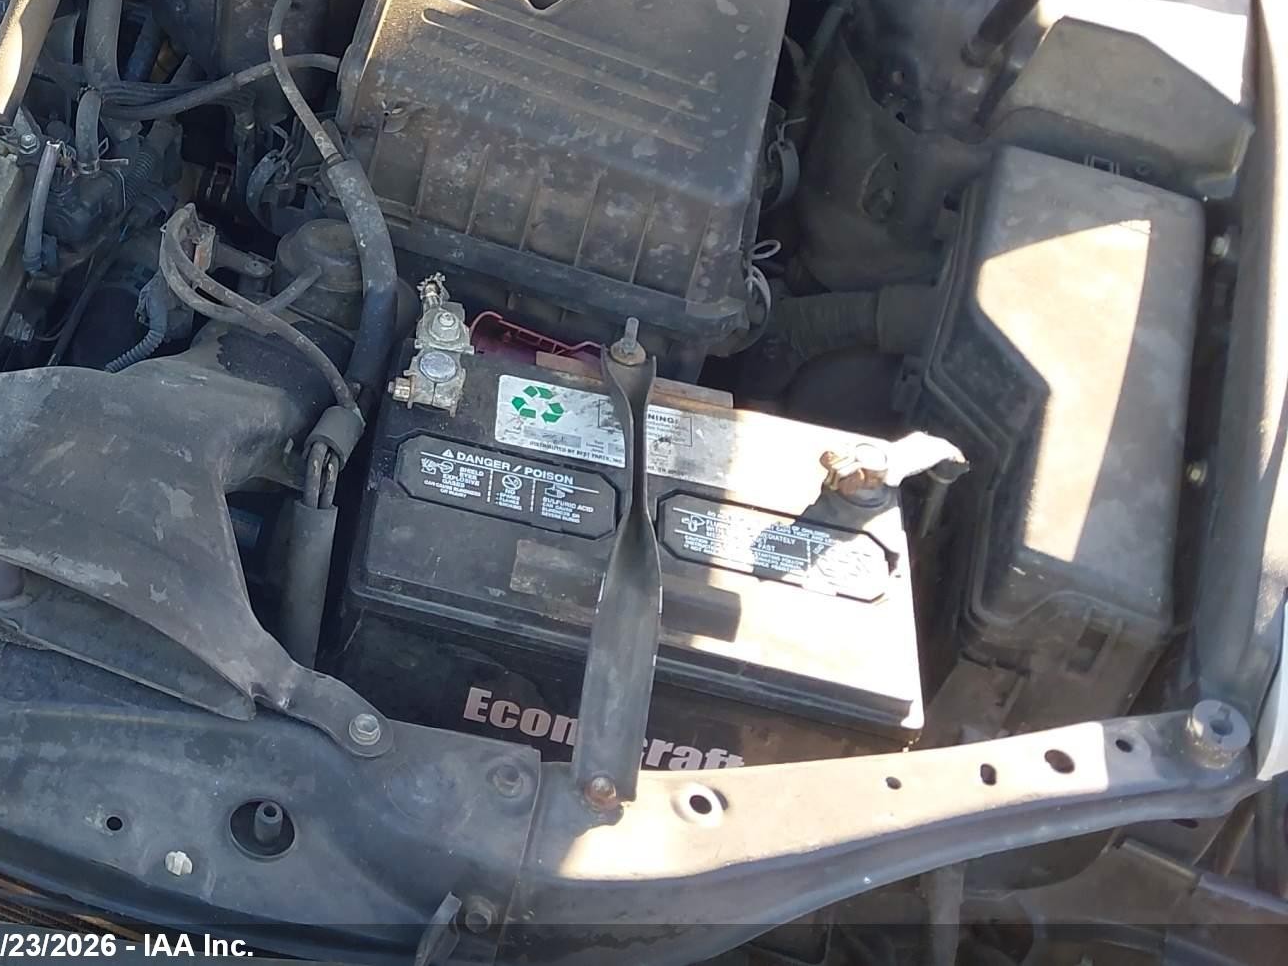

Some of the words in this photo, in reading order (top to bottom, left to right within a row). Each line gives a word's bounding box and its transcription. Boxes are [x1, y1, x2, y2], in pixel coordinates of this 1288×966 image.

[647, 413, 679, 425] NING!
[456, 451, 510, 471] DANGER
[524, 466, 574, 485] POISON
[443, 473, 480, 487] EXPLOSIVE
[543, 496, 576, 509] SULFURIC
[577, 504, 594, 513] ACID
[757, 543, 776, 552] FAST
